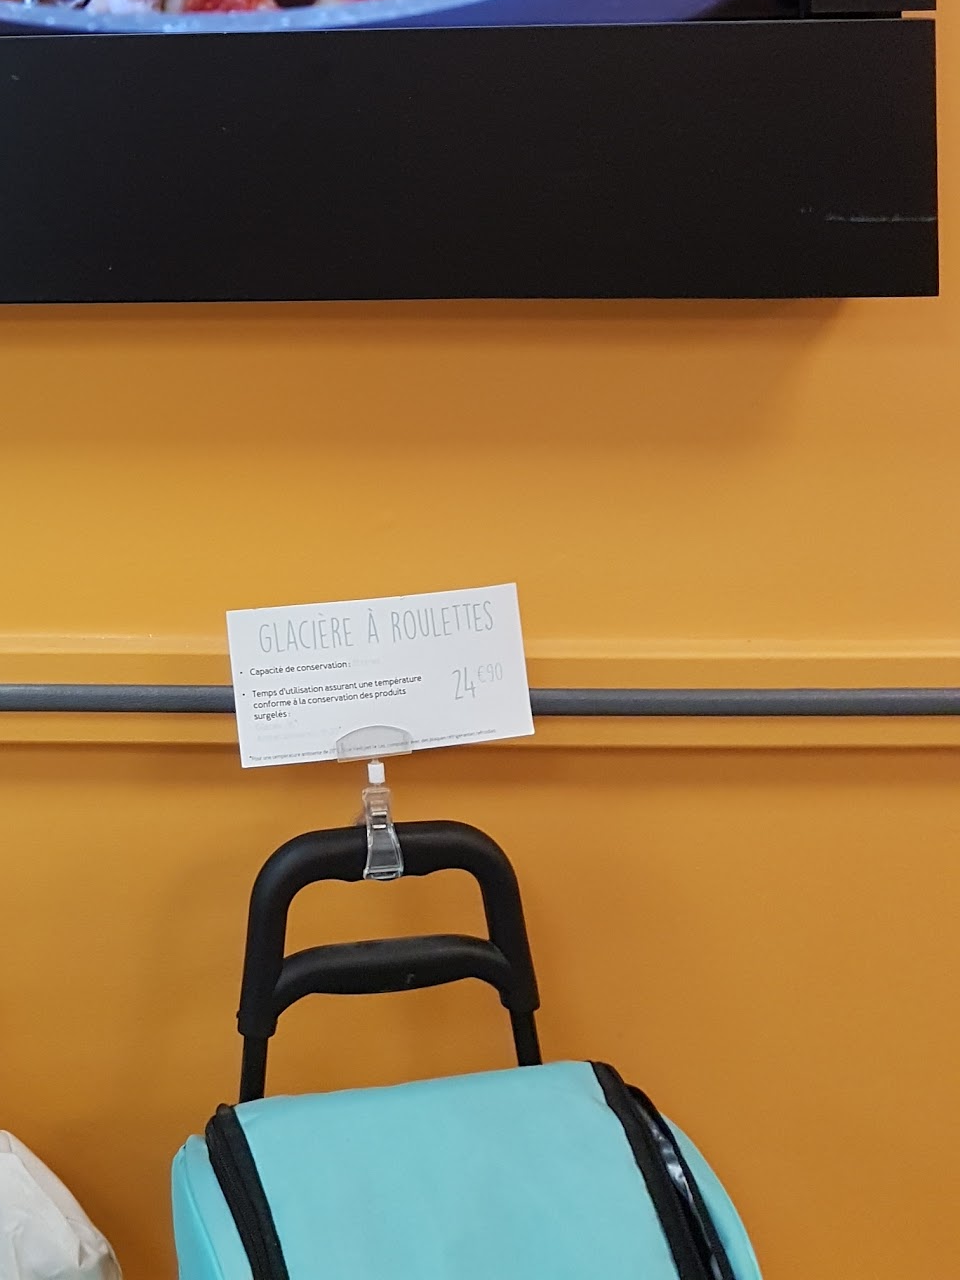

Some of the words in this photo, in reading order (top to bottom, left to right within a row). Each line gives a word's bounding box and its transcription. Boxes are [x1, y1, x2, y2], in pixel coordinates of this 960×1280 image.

[258, 612, 354, 653] GLACIÈRE
[368, 608, 379, 644] À
[391, 601, 493, 643] ROULETTES
[250, 666, 283, 677] Capacité
[286, 665, 295, 674] de
[296, 661, 347, 672] conservation
[252, 688, 277, 699] Temps
[279, 685, 323, 696] d'utilisation
[324, 682, 357, 692] assurant
[358, 680, 373, 689] une
[375, 675, 422, 688] température
[253, 699, 292, 709] conforme
[299, 697, 306, 705] la
[307, 693, 359, 704] conservation
[359, 691, 374, 700] des
[374, 688, 406, 700] produits
[254, 710, 287, 722] surgelés
